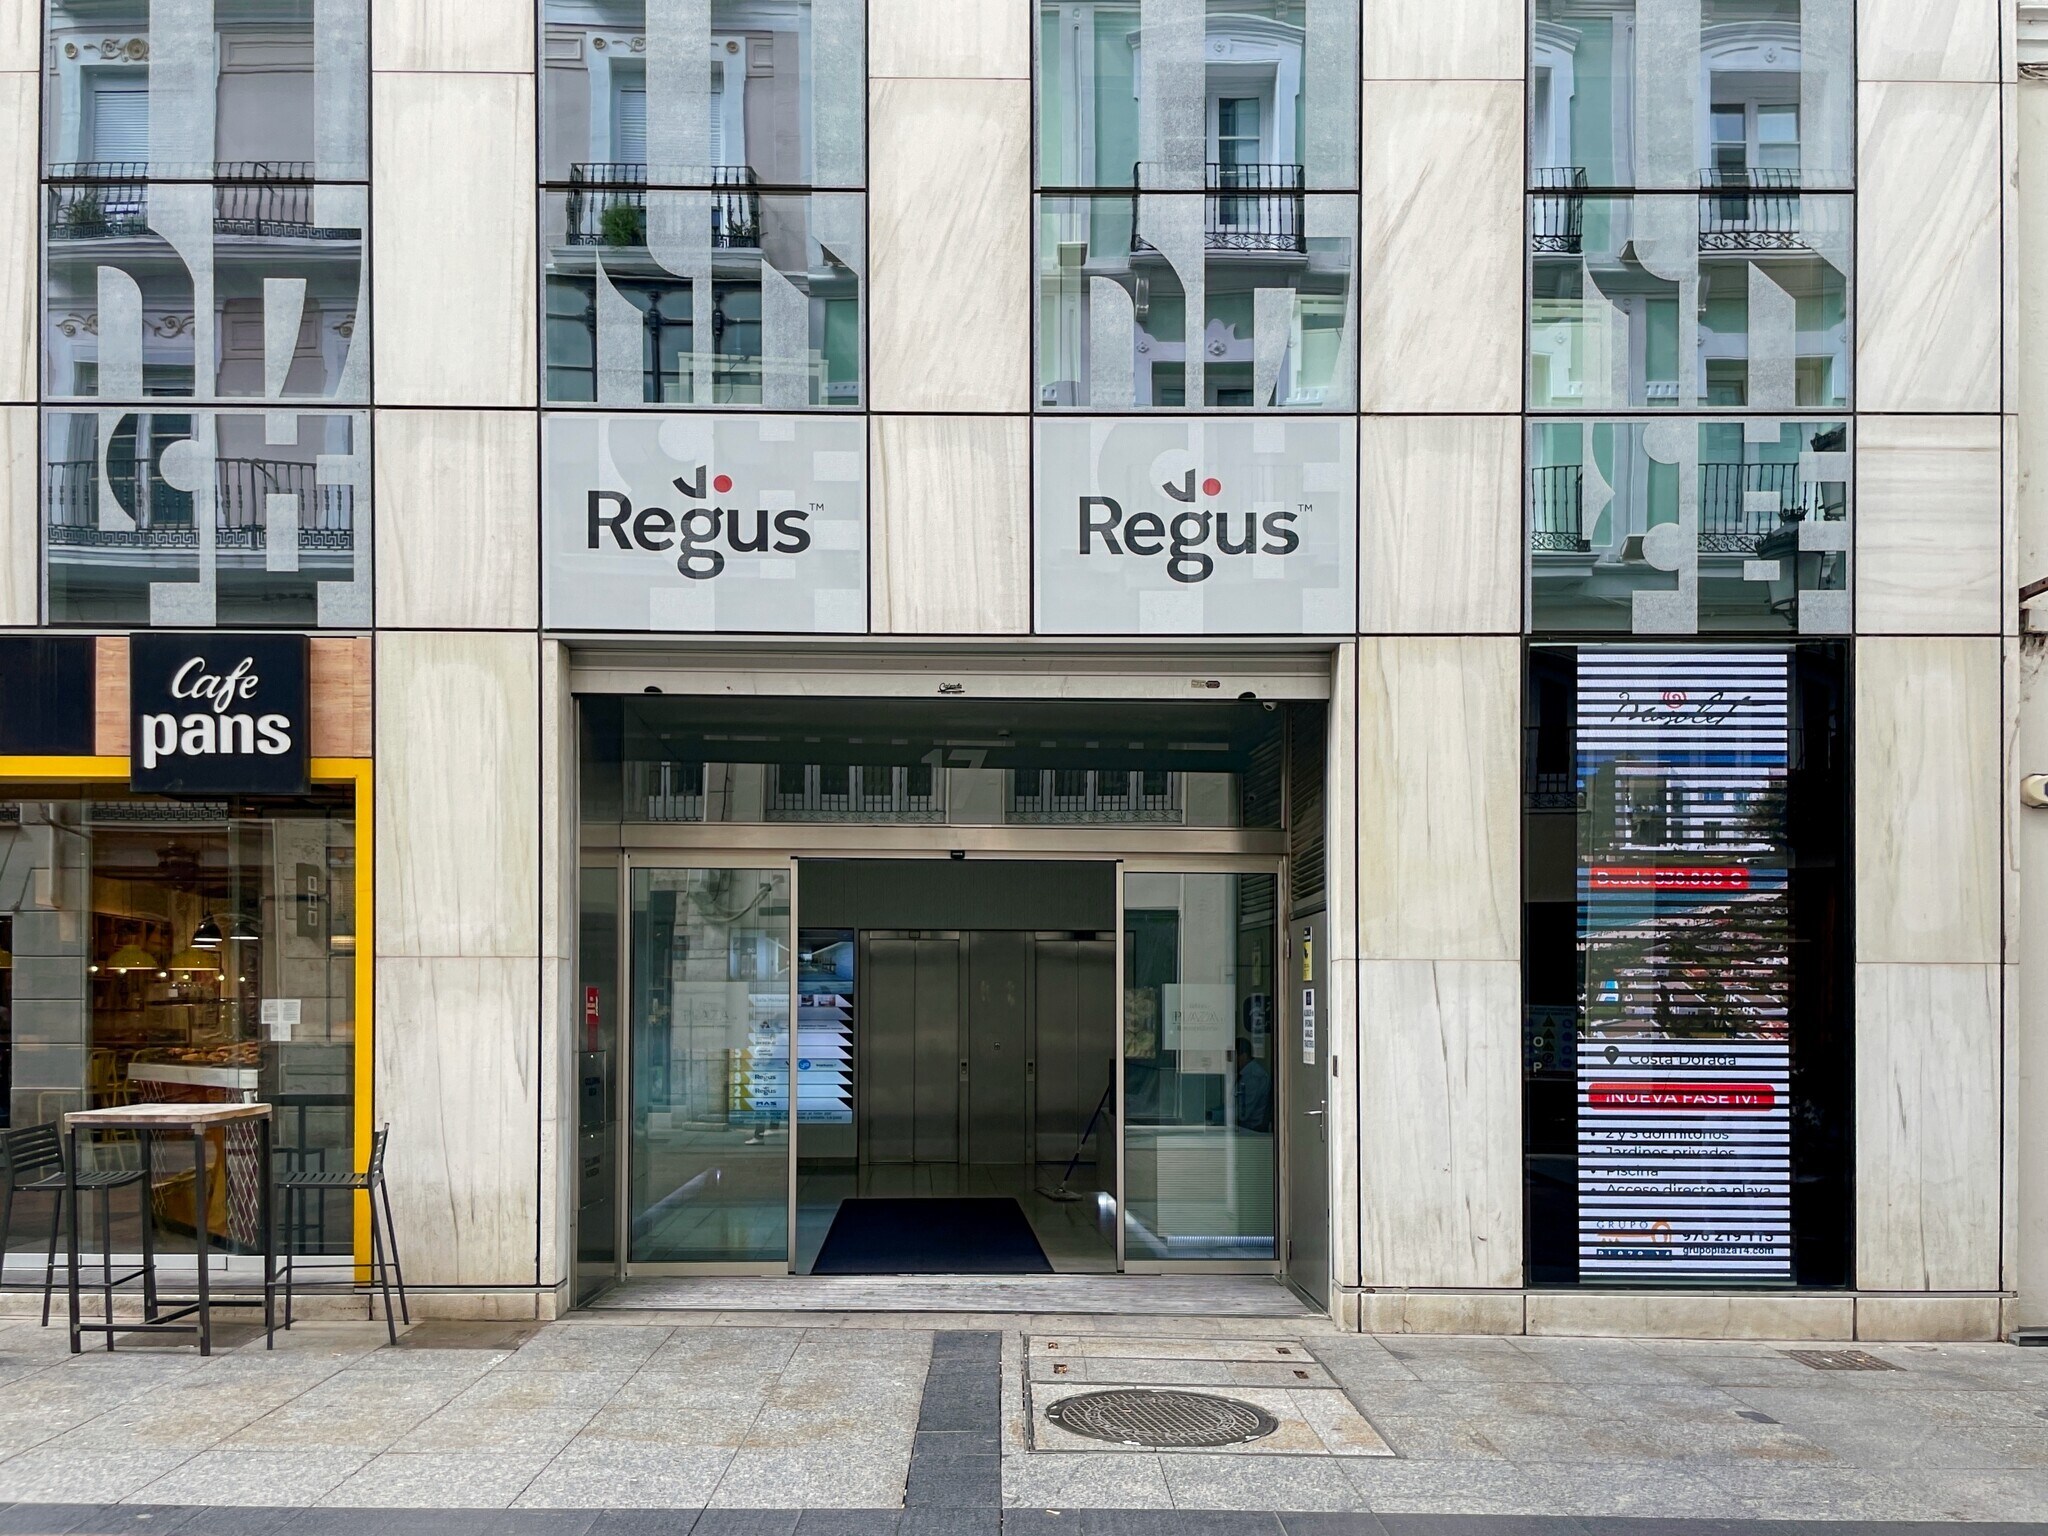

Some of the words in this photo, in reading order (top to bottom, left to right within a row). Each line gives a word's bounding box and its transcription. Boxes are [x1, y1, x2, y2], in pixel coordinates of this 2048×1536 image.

[588, 490, 811, 579] Regus
[1079, 496, 1299, 583] Regus
[171, 656, 260, 713] Cafe
[142, 713, 292, 769] pans
[1629, 1054, 1673, 1066] Costa
[1680, 1054, 1737, 1066] Dorada
[1684, 1093, 1730, 1104] FASE
[1642, 1130, 1729, 1140] dormitorios
[1606, 1146, 1668, 1157] Jardines
[1673, 1147, 1736, 1159] privados
[1606, 1165, 1659, 1176] Piscina
[1606, 1184, 1660, 1194] Acceso
[1664, 1183, 1716, 1194] directo
[1733, 1183, 1771, 1198] playa
[1596, 1220, 1648, 1229] GRUPO
[1682, 1246, 1774, 1257] grupoplaza14.com
